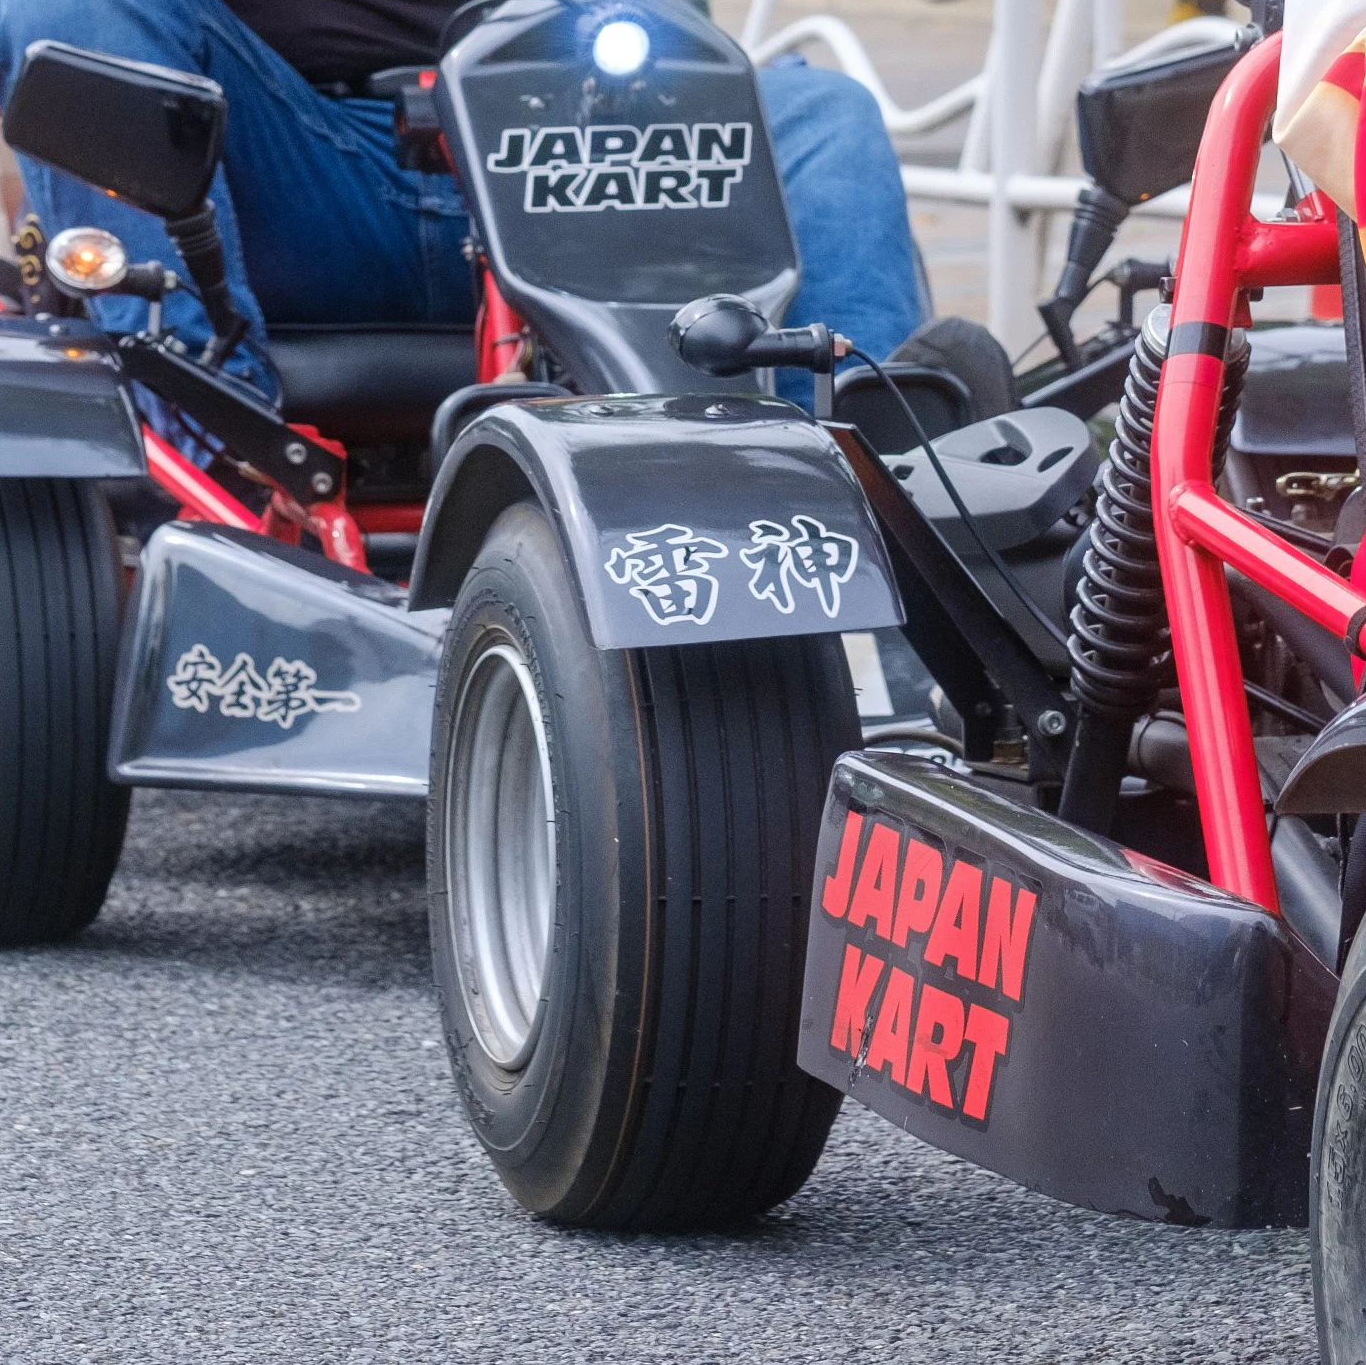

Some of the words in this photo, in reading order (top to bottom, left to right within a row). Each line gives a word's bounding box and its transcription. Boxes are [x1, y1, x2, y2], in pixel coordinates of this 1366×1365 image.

[488, 123, 752, 172] JAPAN
[524, 167, 743, 213] KART
[605, 515, 859, 625] 雷神
[822, 810, 1037, 1002] JAPAN
[830, 943, 1010, 1121] KART
